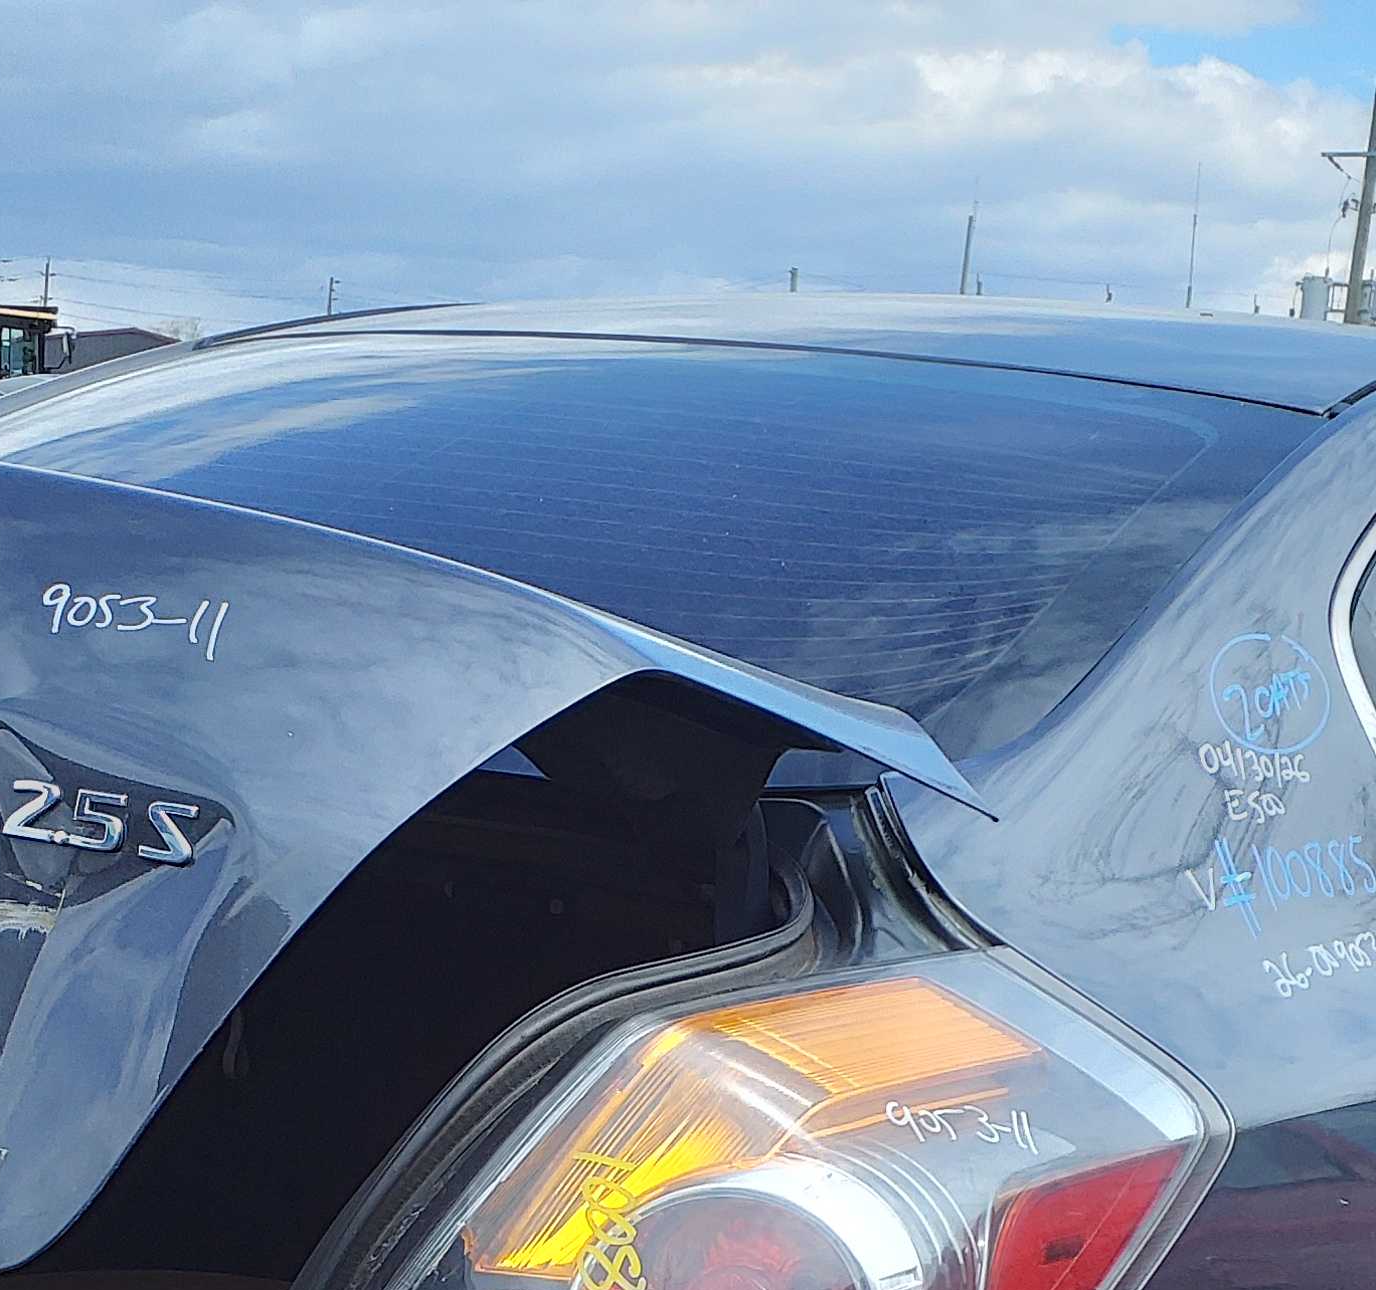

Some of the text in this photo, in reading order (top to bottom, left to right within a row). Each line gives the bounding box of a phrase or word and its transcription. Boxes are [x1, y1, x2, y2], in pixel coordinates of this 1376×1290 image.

[42, 582, 230, 662] 9053-11
[2, 779, 201, 866] 2.5 S
[885, 1099, 1040, 1157] 9053-11
